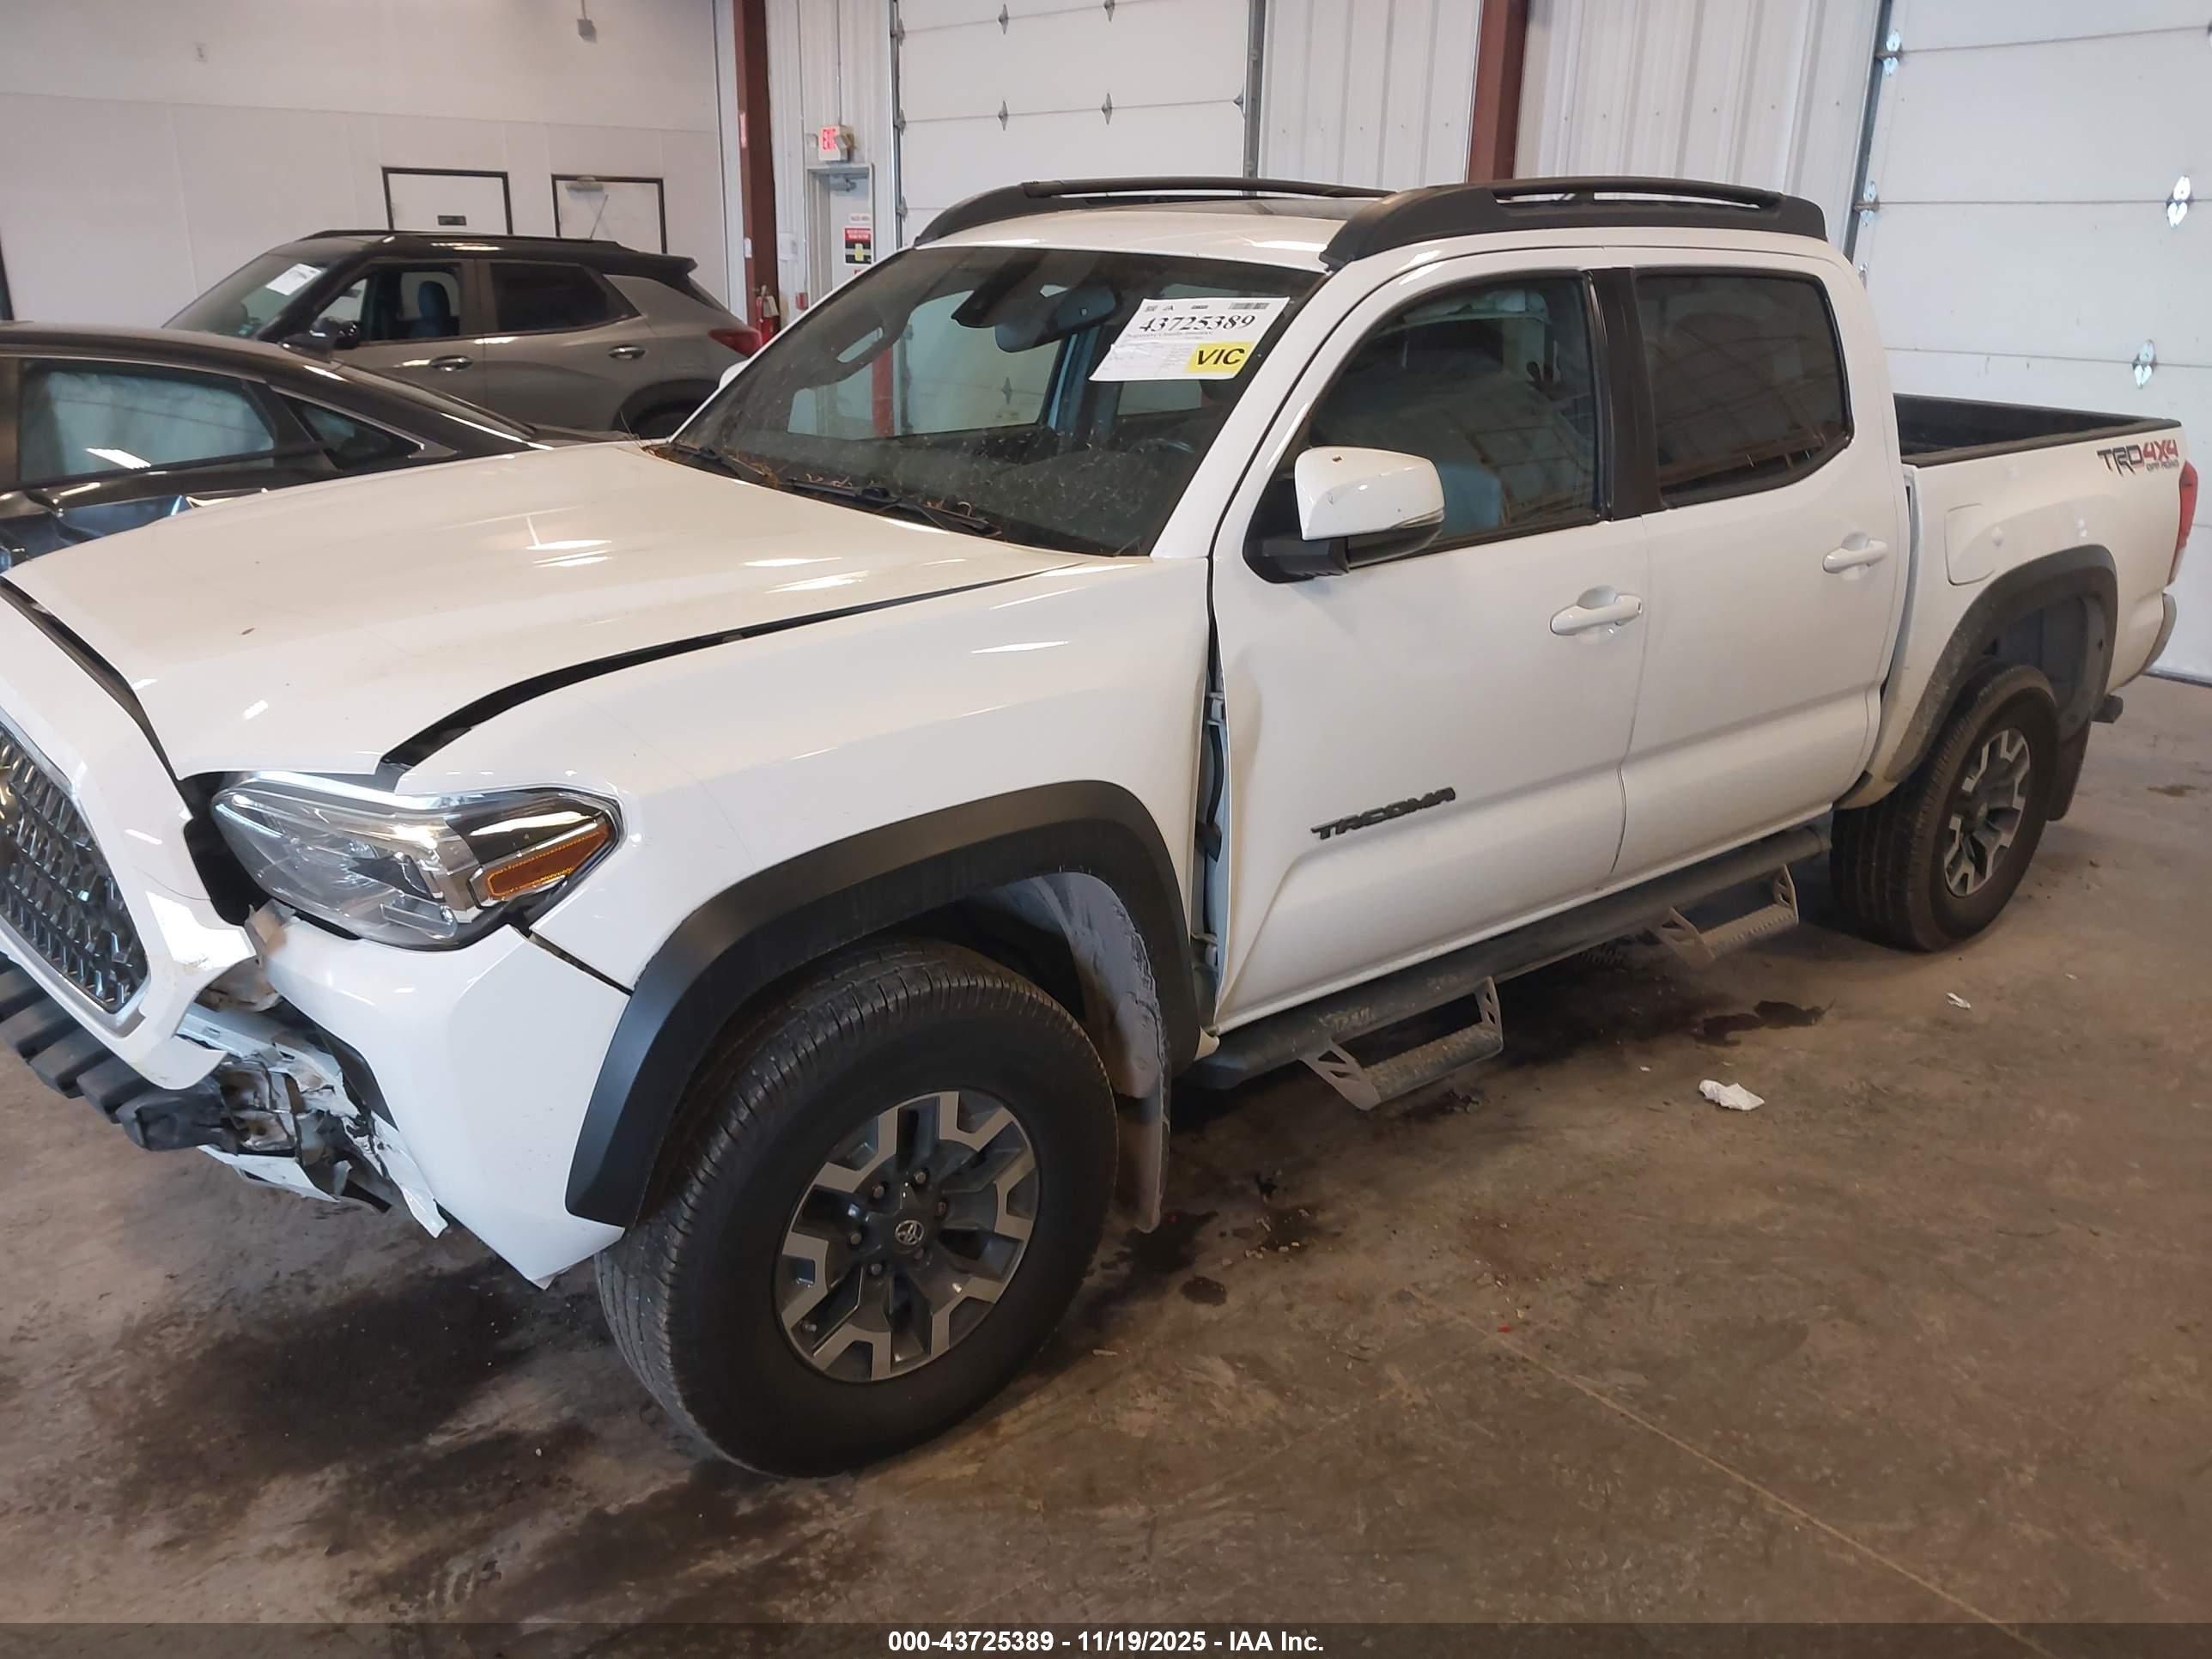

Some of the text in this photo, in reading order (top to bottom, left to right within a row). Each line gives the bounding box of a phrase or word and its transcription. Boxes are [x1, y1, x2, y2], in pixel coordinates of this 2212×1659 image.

[1139, 314, 1255, 331] 43725389
[1197, 348, 1245, 366] VIC
[1310, 787, 1456, 841] TACOMA
